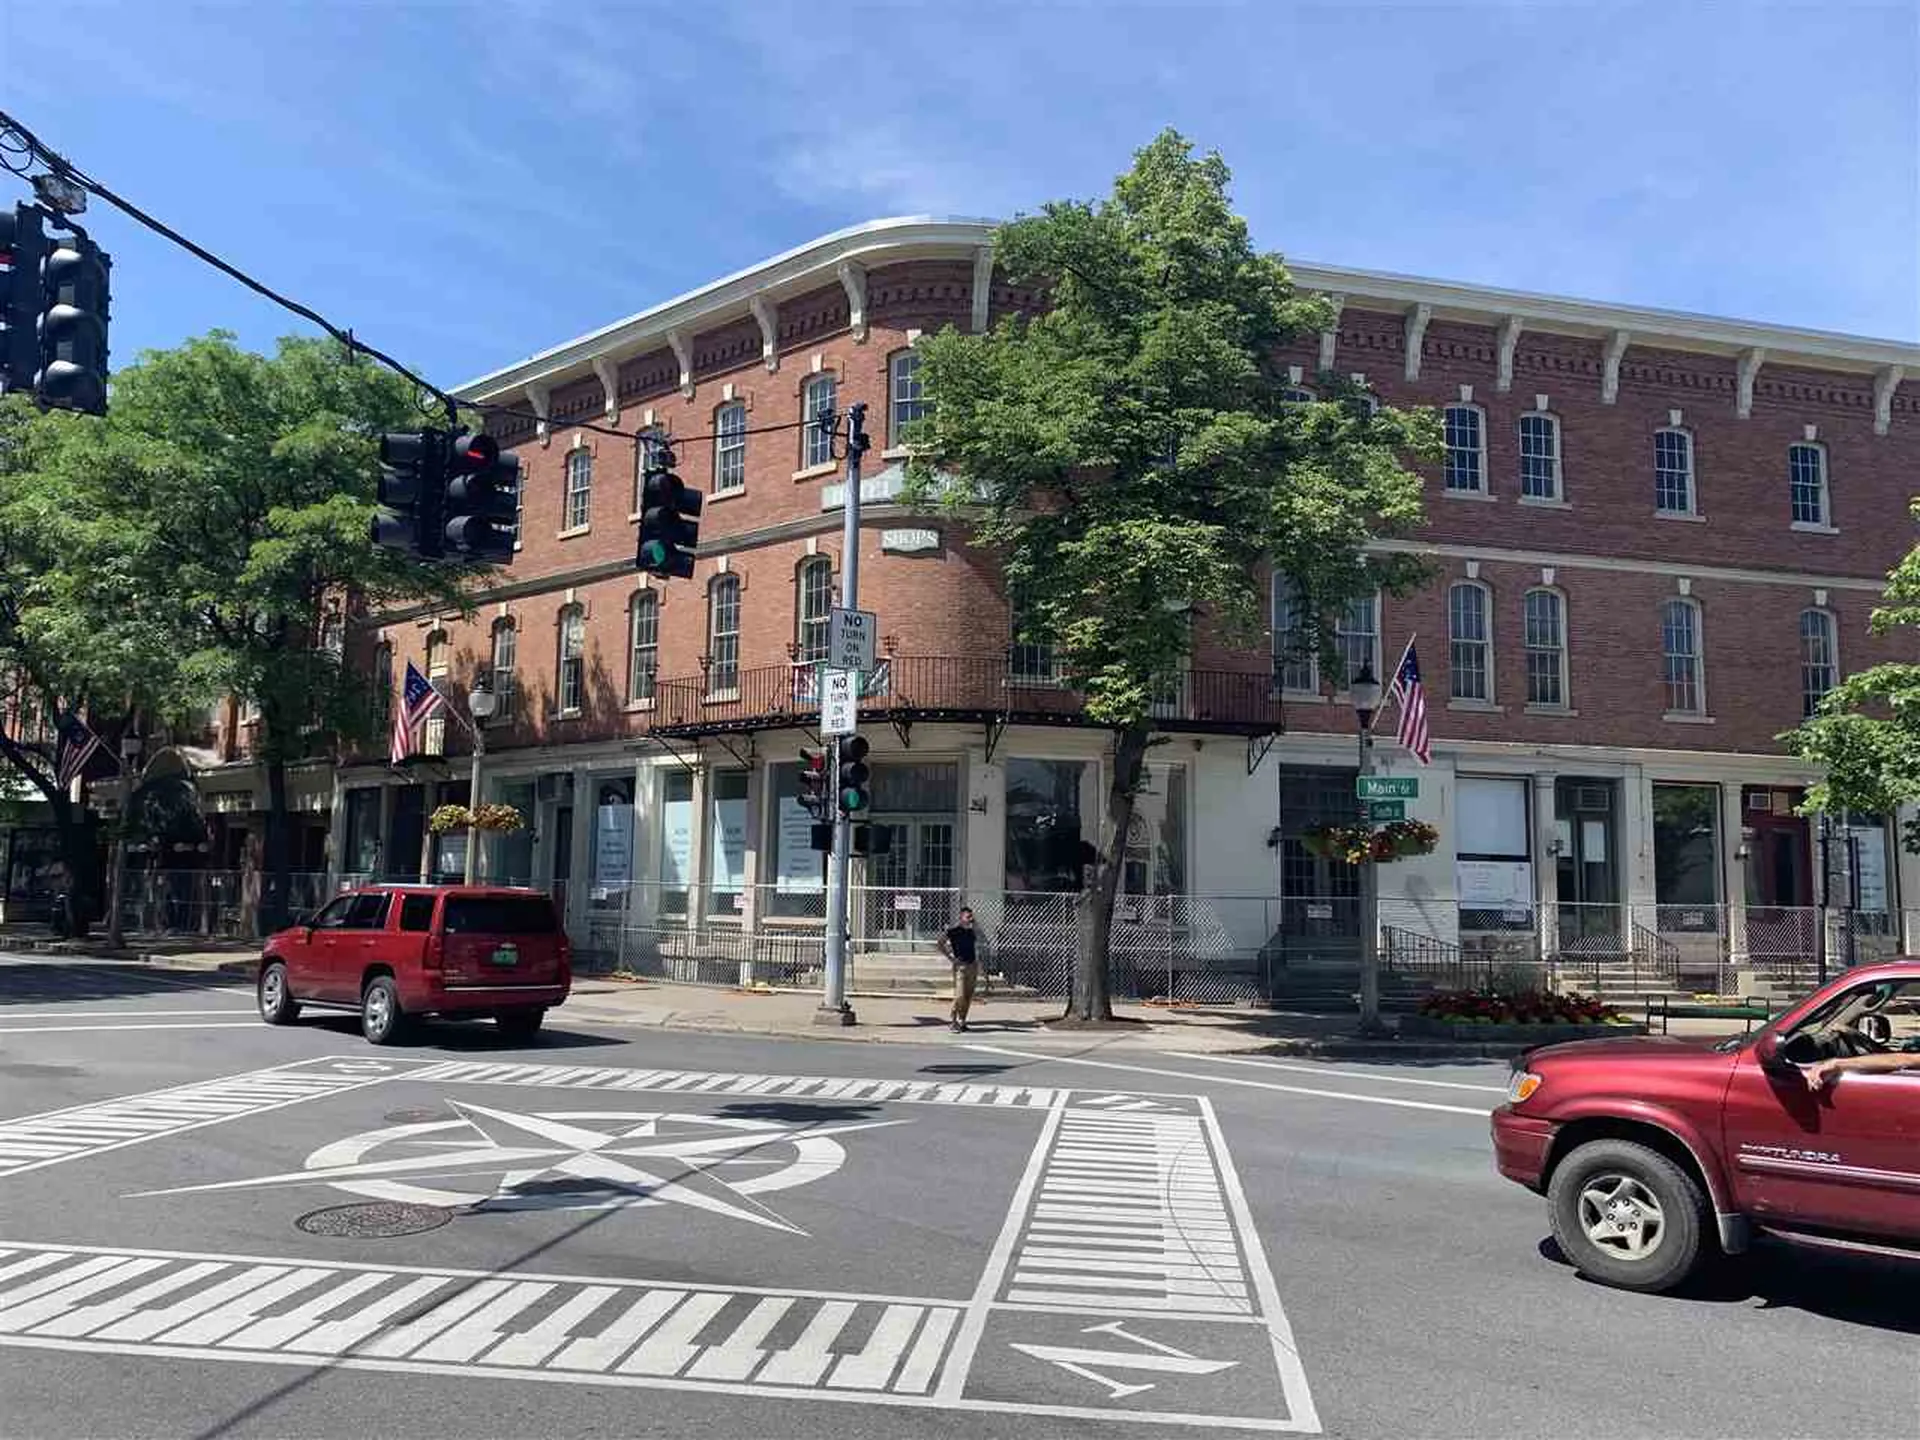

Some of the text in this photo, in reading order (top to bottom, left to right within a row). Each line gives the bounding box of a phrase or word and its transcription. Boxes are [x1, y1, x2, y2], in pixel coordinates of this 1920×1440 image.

[883, 530, 938, 546] SHOPS
[844, 614, 862, 627] NO
[840, 628, 866, 641] TURN
[845, 642, 859, 653] ON
[842, 655, 862, 666] RED
[832, 677, 847, 690] NO
[830, 692, 849, 703] TURN
[1367, 780, 1397, 795] Main
[1774, 1147, 1841, 1162] TUNDRA
